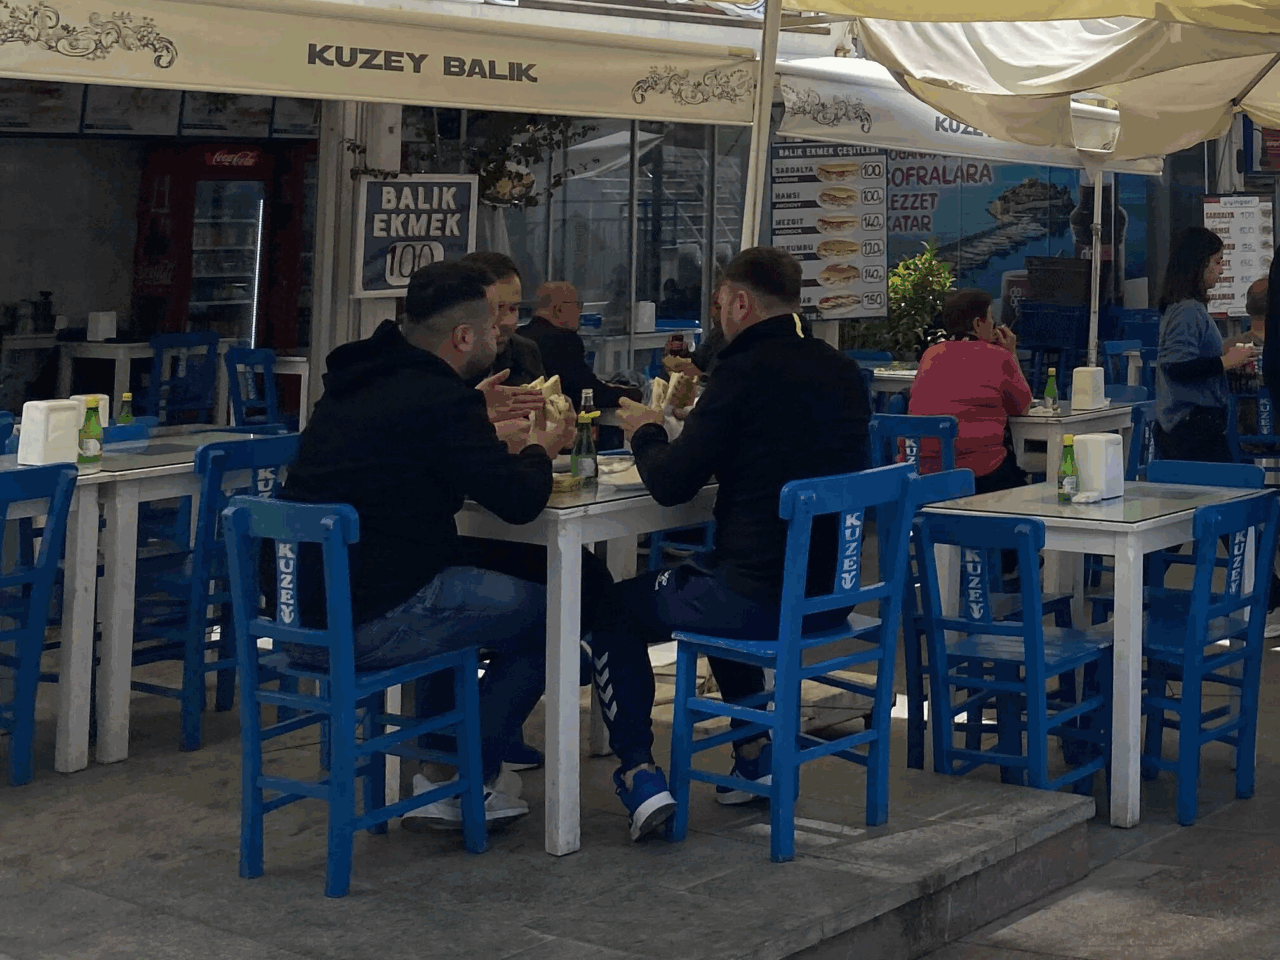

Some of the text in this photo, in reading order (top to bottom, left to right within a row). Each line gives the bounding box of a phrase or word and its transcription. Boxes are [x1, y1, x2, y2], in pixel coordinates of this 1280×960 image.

[307, 43, 538, 82] KUZEY BALIK
[806, 146, 834, 156] EKMEK
[887, 163, 993, 187] OFRALARA
[381, 186, 457, 210] BALIK
[888, 192, 938, 211] EZZET
[373, 213, 462, 238] EKMEK
[904, 438, 917, 464] KUZ
[841, 512, 861, 590] KUZEY
[1229, 530, 1246, 595] KUZEY
[278, 543, 296, 624] KUZEY
[964, 548, 984, 620] KUZEY
